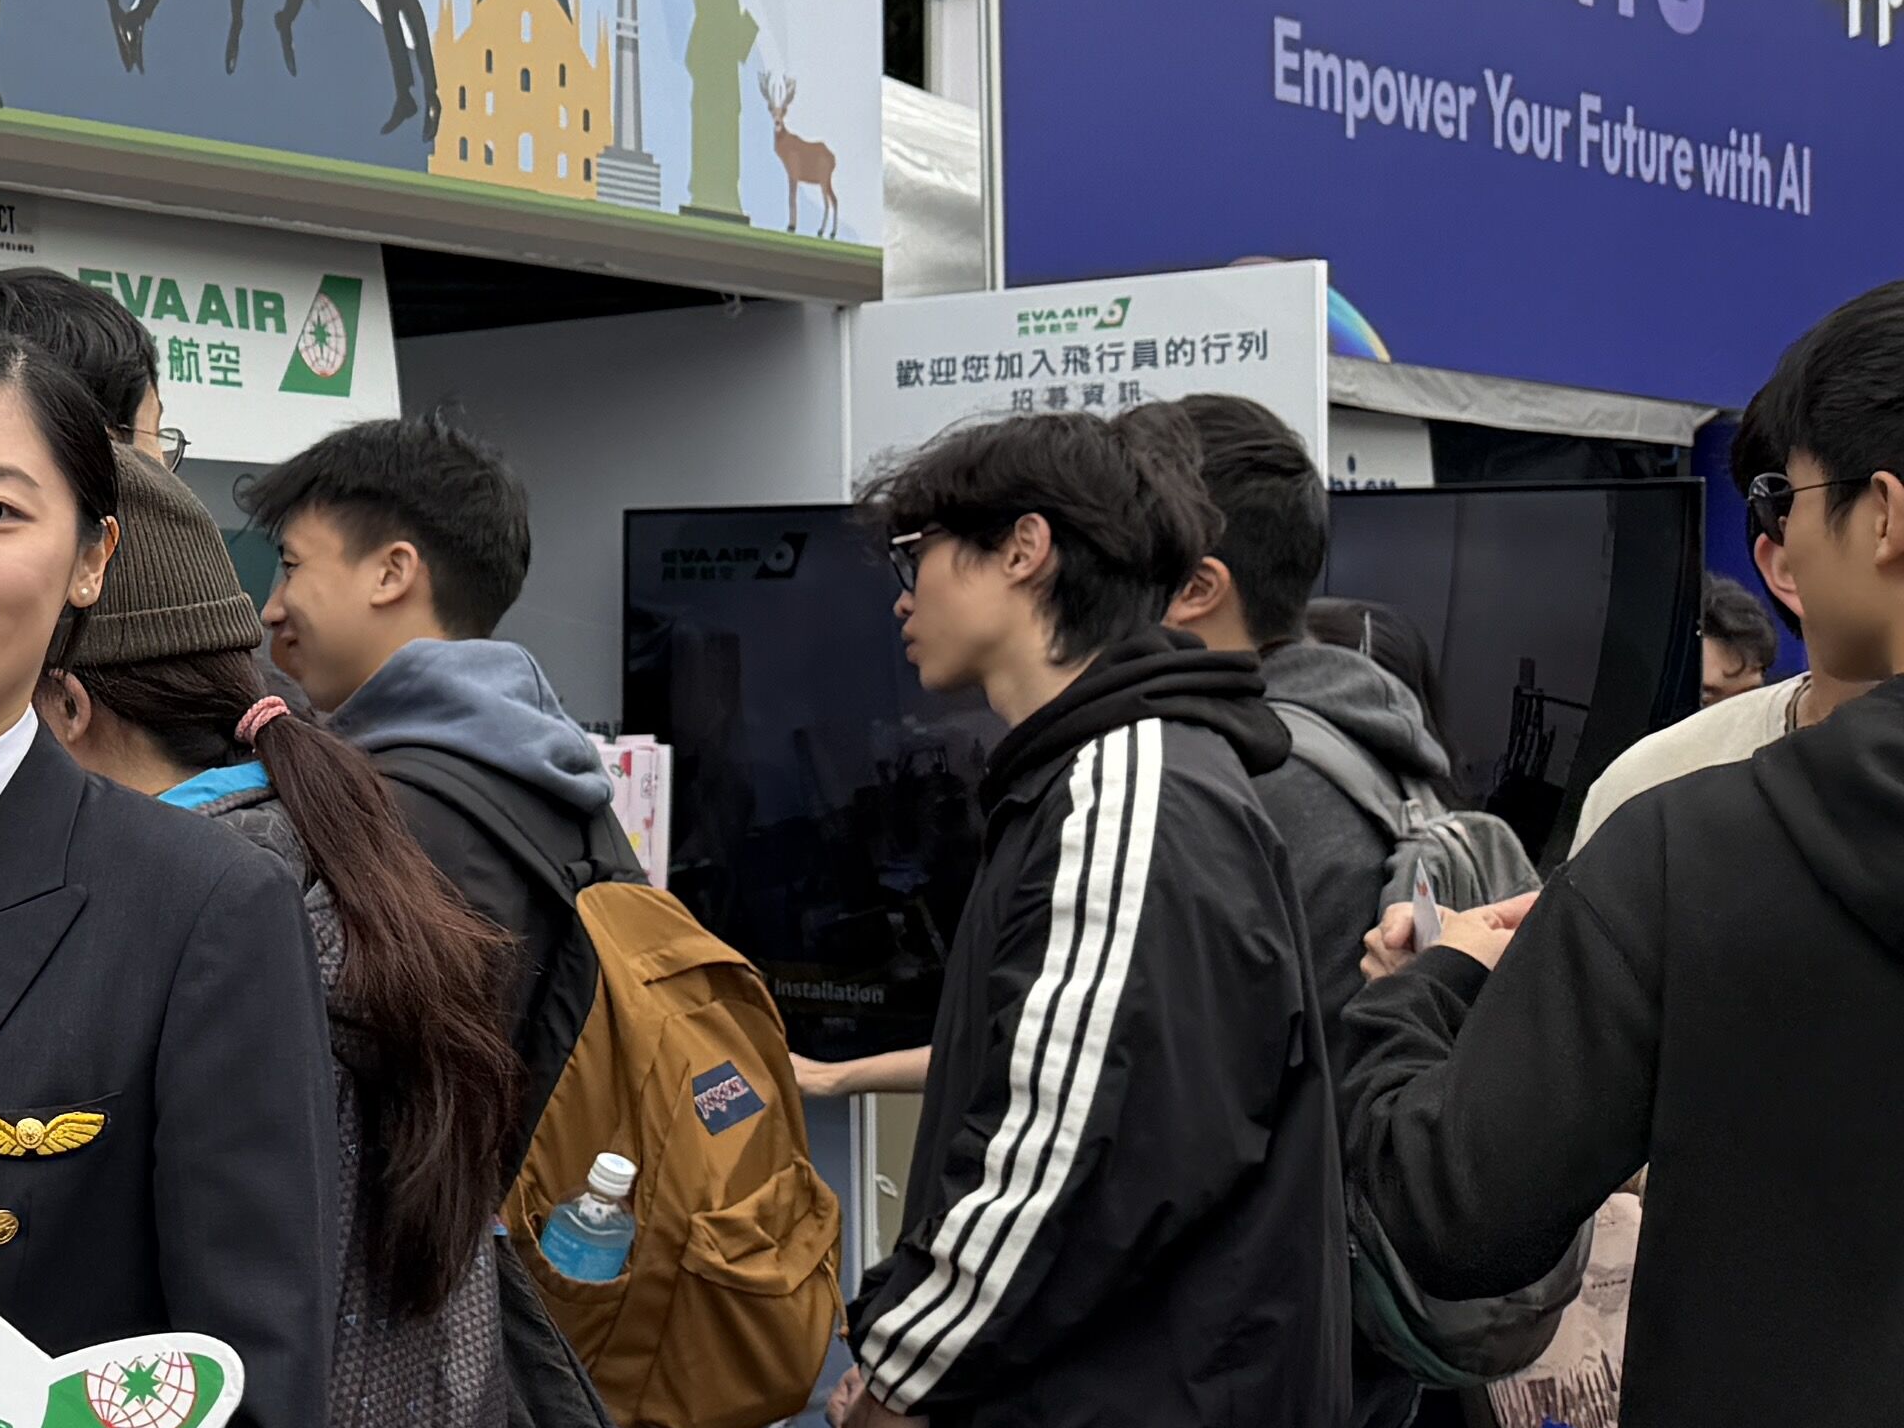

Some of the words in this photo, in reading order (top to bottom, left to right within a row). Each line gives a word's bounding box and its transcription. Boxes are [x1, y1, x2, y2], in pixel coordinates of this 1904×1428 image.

[1273, 15, 1476, 142] Empower
[1483, 68, 1572, 162] Your
[1578, 93, 1693, 190] Future
[1699, 127, 1772, 209] with
[1777, 146, 1812, 216] AI
[895, 328, 1269, 389] 歡迎您加入飛行員的行列
[1011, 382, 1144, 412] 招募資訊
